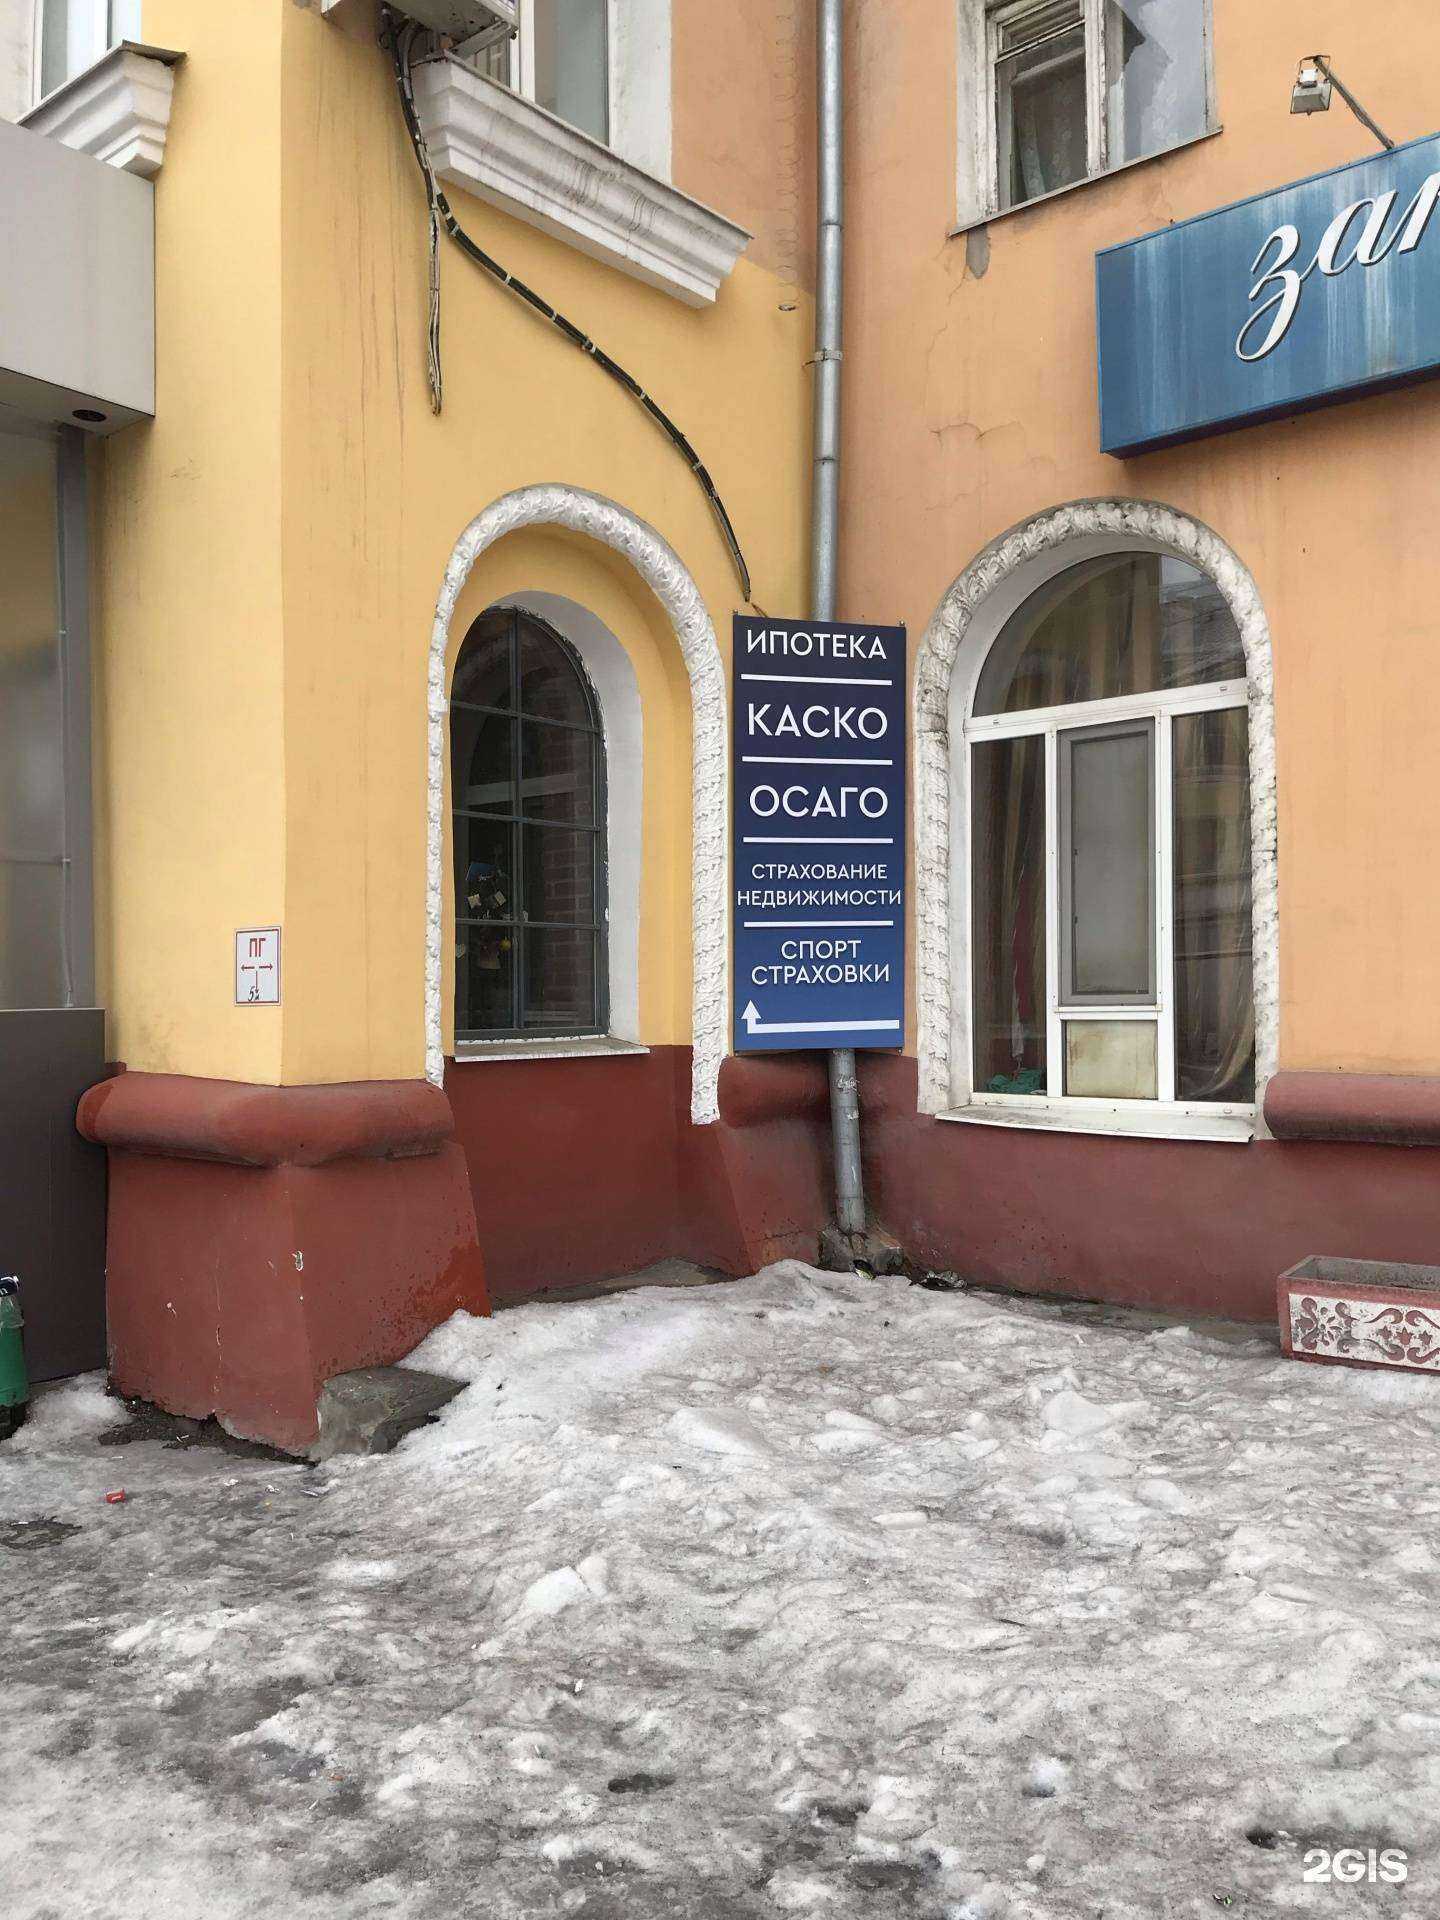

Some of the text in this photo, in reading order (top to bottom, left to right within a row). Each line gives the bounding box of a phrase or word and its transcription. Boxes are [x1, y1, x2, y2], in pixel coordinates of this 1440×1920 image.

[747, 630, 888, 660] ИПОТЕКА
[747, 703, 888, 739] КАСКО
[750, 784, 888, 818] ОСАГО
[751, 864, 888, 880] СТРАХОВАНИЕ
[737, 890, 902, 908] НЕДВИЖИМОСТИ
[249, 937, 266, 957] ПГ
[781, 940, 862, 960] СПОРТ
[751, 964, 890, 985] СТРАХОВКИ
